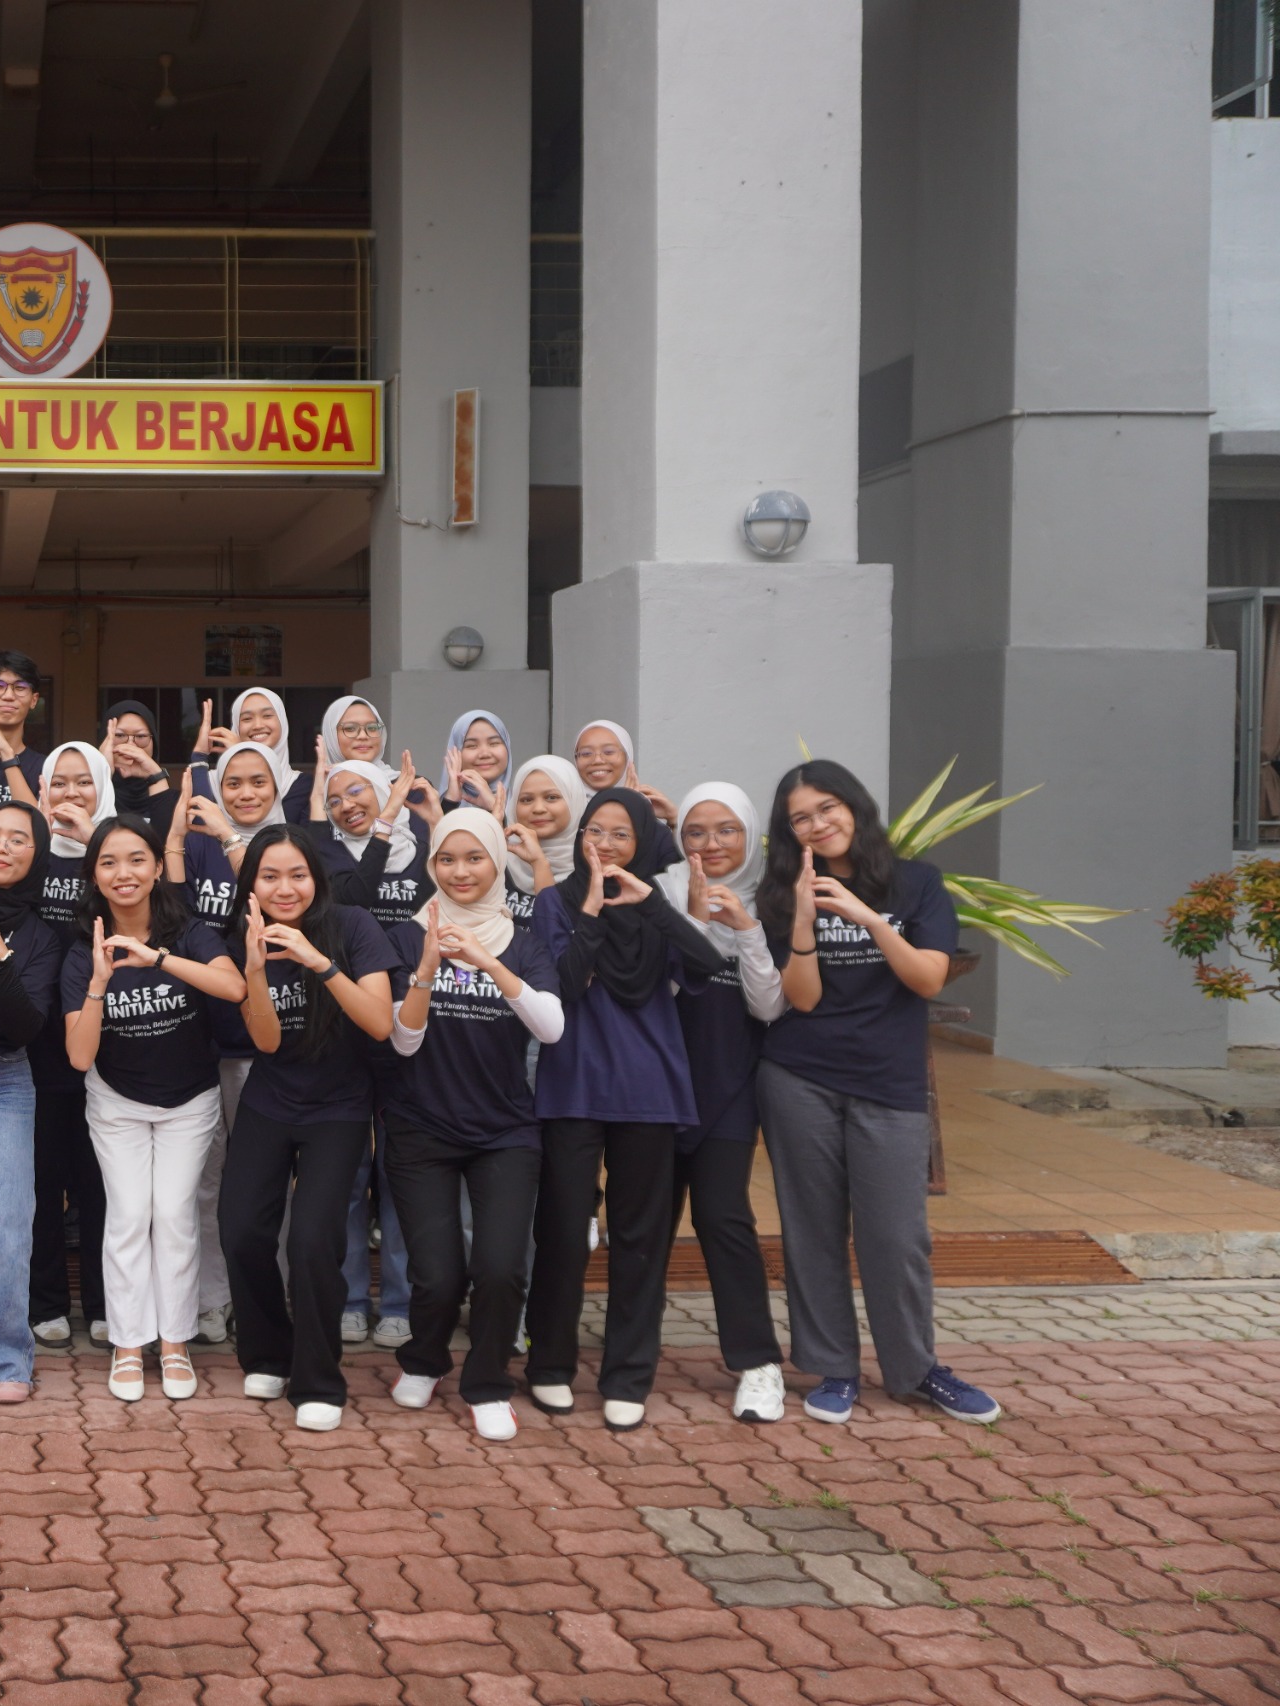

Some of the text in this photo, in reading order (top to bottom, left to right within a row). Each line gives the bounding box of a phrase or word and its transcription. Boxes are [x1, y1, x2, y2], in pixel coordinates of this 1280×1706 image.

[136, 400, 355, 452] BERJASA
[107, 986, 152, 1006] BASE
[108, 994, 187, 1019] INITIATIVE
